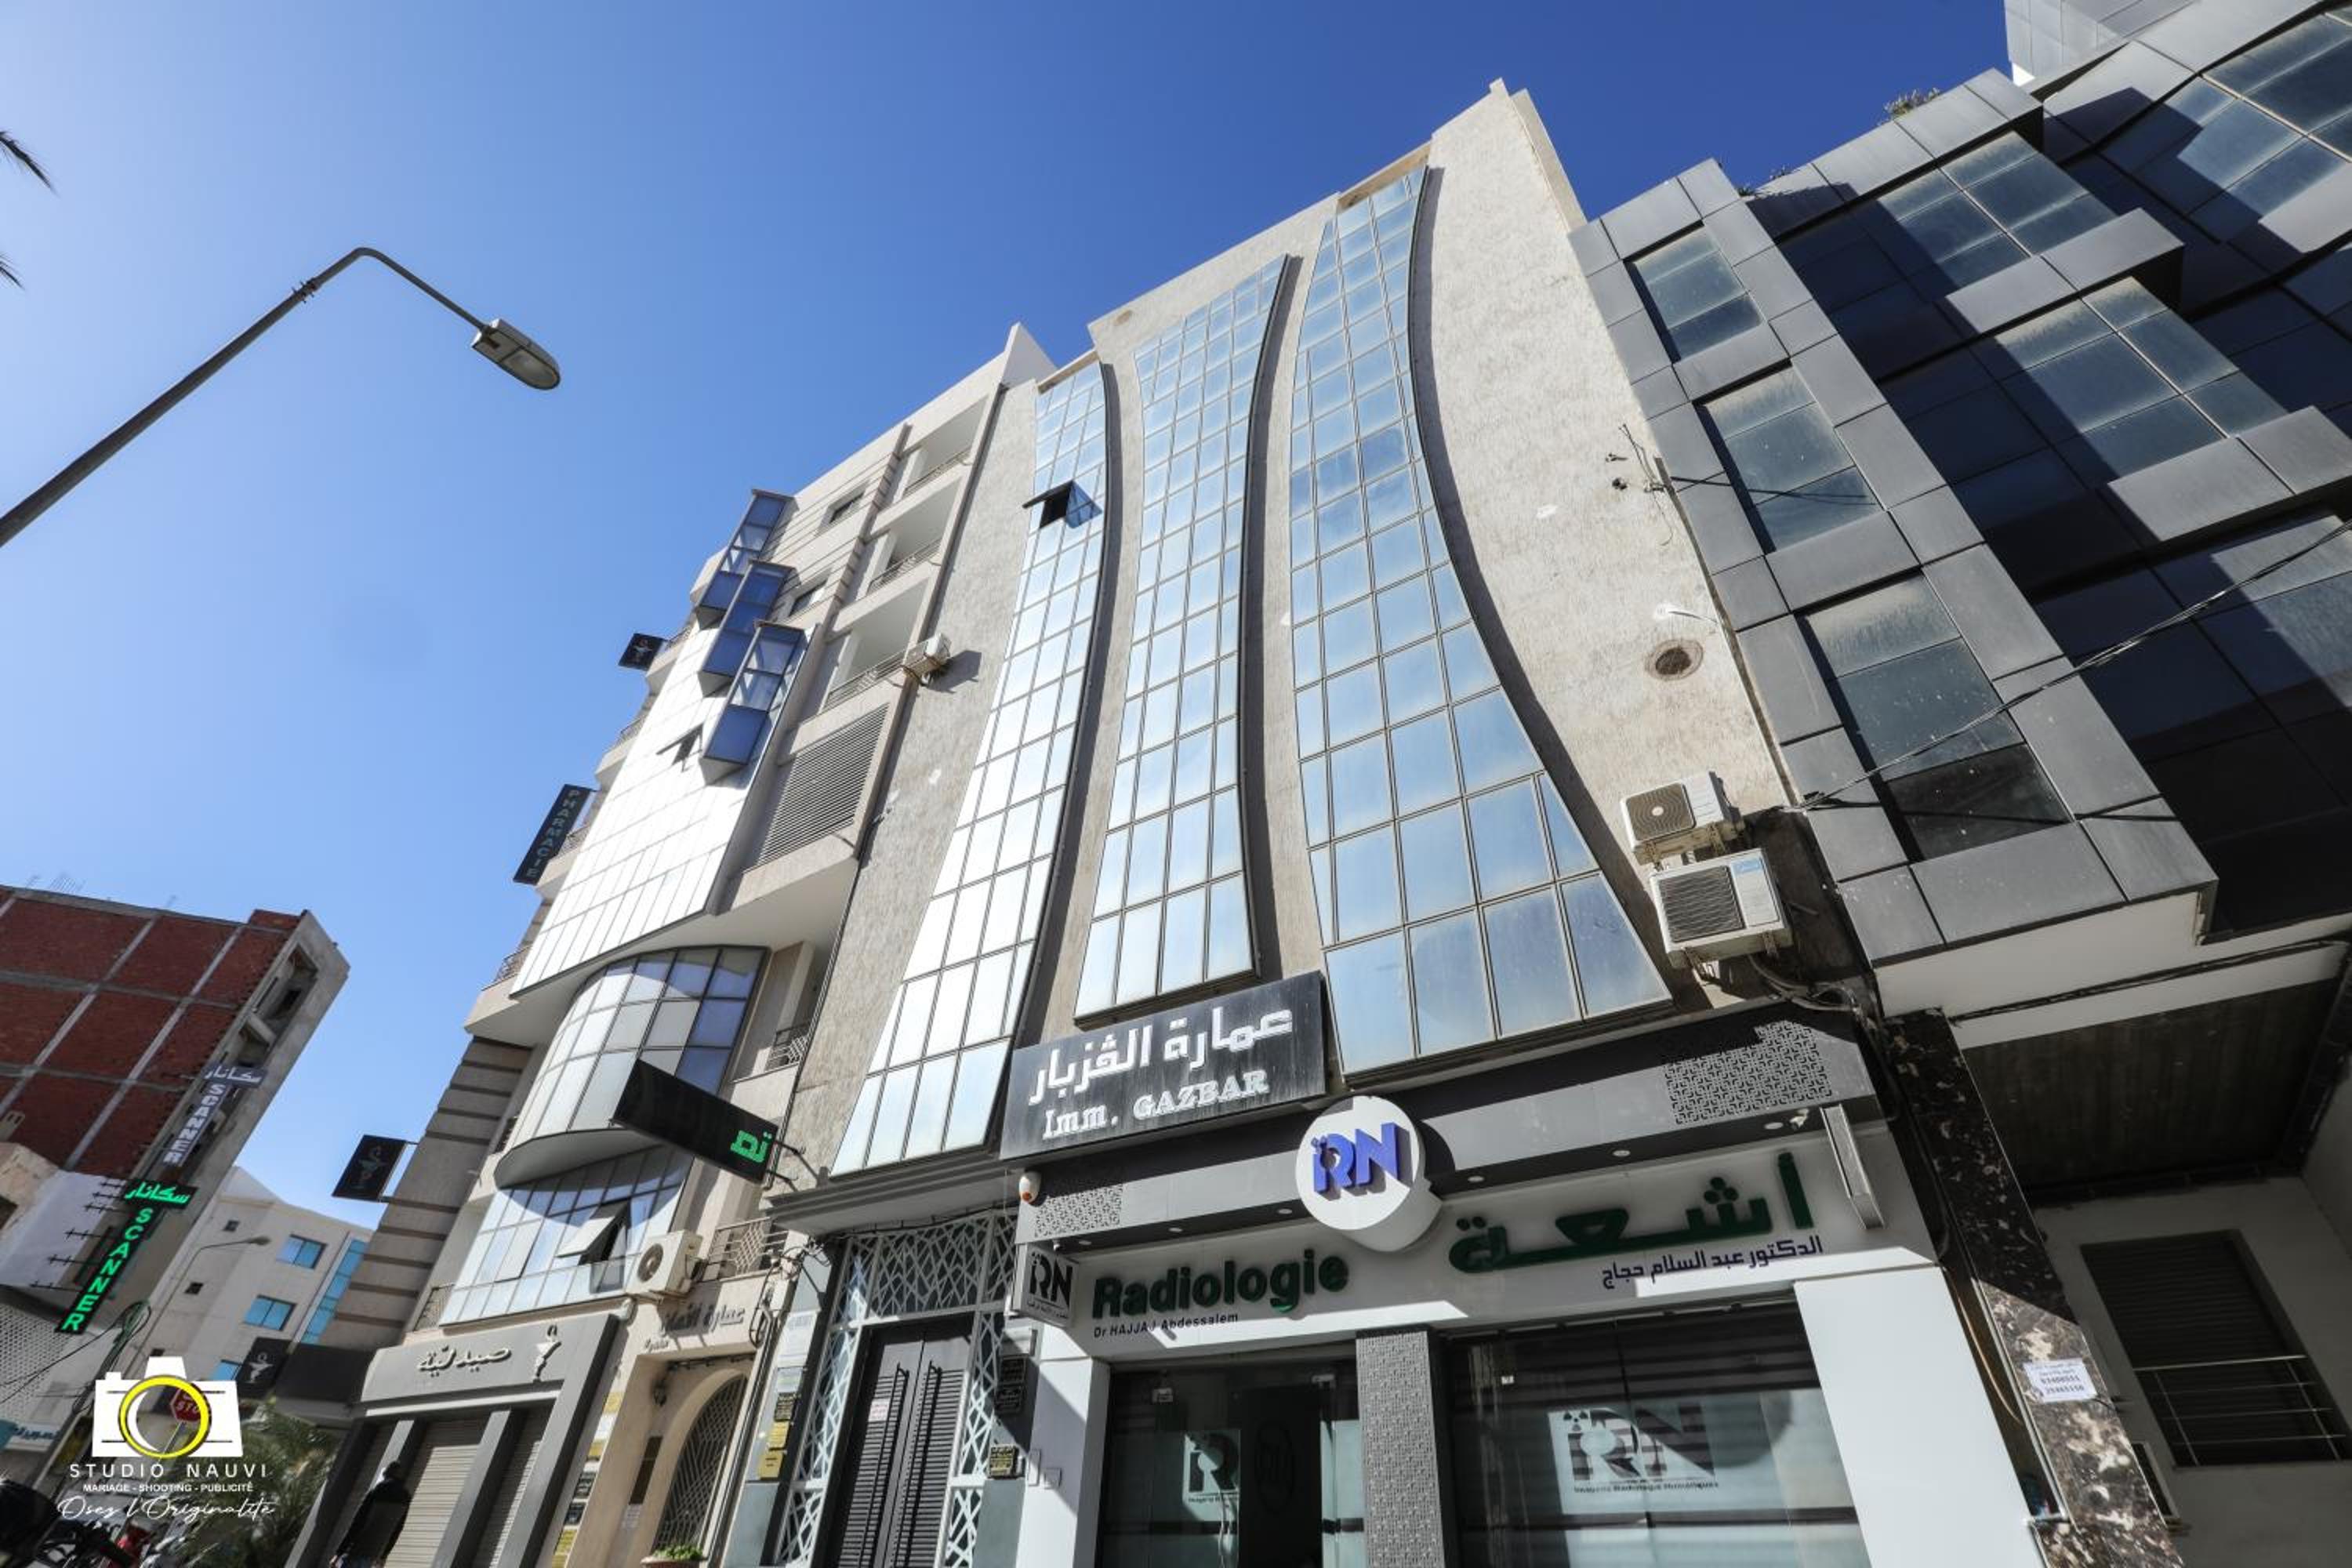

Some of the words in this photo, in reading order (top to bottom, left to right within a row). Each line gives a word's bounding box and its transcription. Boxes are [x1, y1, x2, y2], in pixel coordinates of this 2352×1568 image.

[526, 789, 579, 877] PHARMACIE
[1163, 1006, 1293, 1072] عمارة
[163, 1083, 227, 1163] SCANNER
[1042, 1103, 1119, 1141] Imm.
[1133, 1069, 1270, 1120] GAZBAR
[125, 1181, 190, 1204] سكانار
[61, 1207, 154, 1330] SCANNER
[1602, 1261, 1644, 1290] حجاج
[1650, 1250, 1708, 1283] السلام
[1712, 1253, 1744, 1269] عبد
[1749, 1236, 1824, 1269] الدكتور
[1092, 1248, 1349, 1319] Radiologie
[1094, 1326, 1106, 1338] Dr
[1109, 1320, 1156, 1336] HAJJAJ
[1161, 1312, 1239, 1330] Abdessalem
